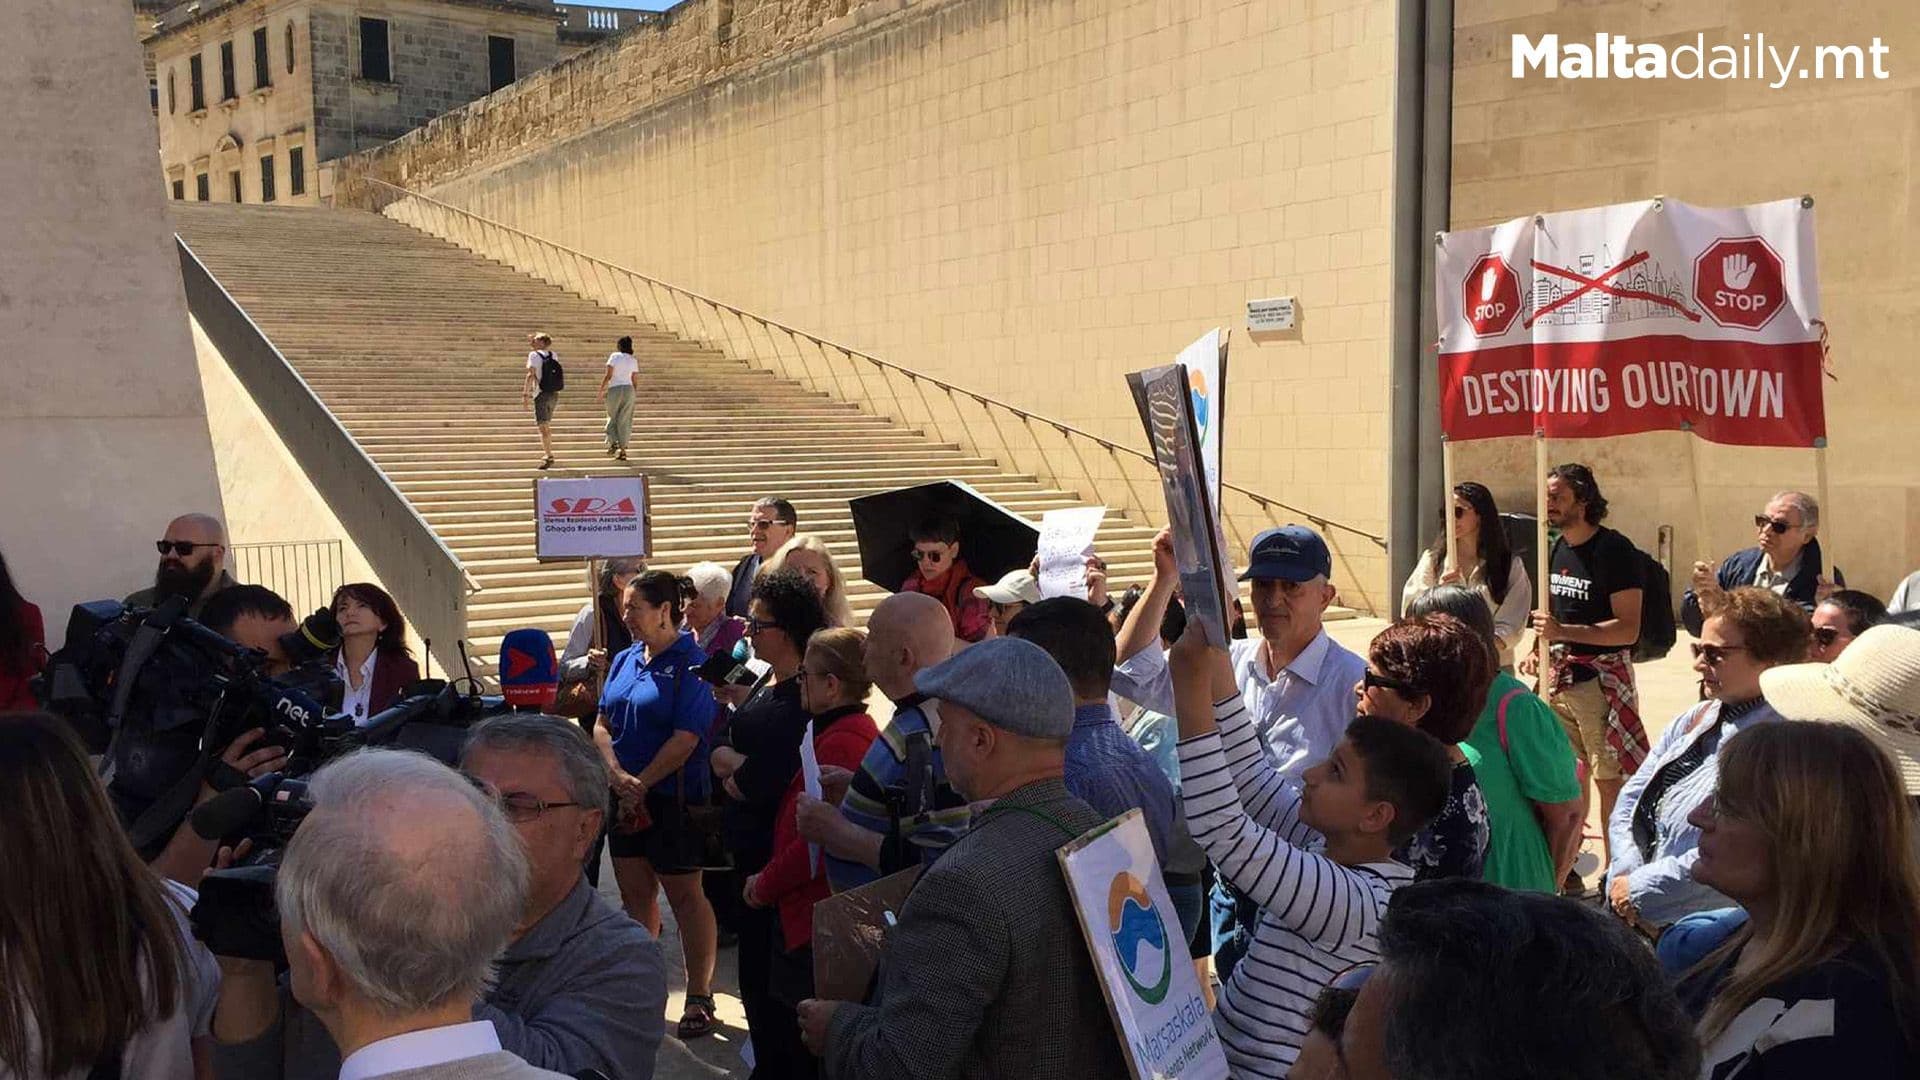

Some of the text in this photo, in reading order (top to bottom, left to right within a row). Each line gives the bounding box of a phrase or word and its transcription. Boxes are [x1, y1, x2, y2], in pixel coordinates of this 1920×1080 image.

[1474, 301, 1506, 322] STOP
[1714, 289, 1768, 313] STOP
[1621, 361, 1691, 408] OUR
[545, 496, 636, 513] SRA
[276, 696, 310, 728] net
[1135, 993, 1205, 1072] Marsaskala
[1182, 1024, 1215, 1064] Network
